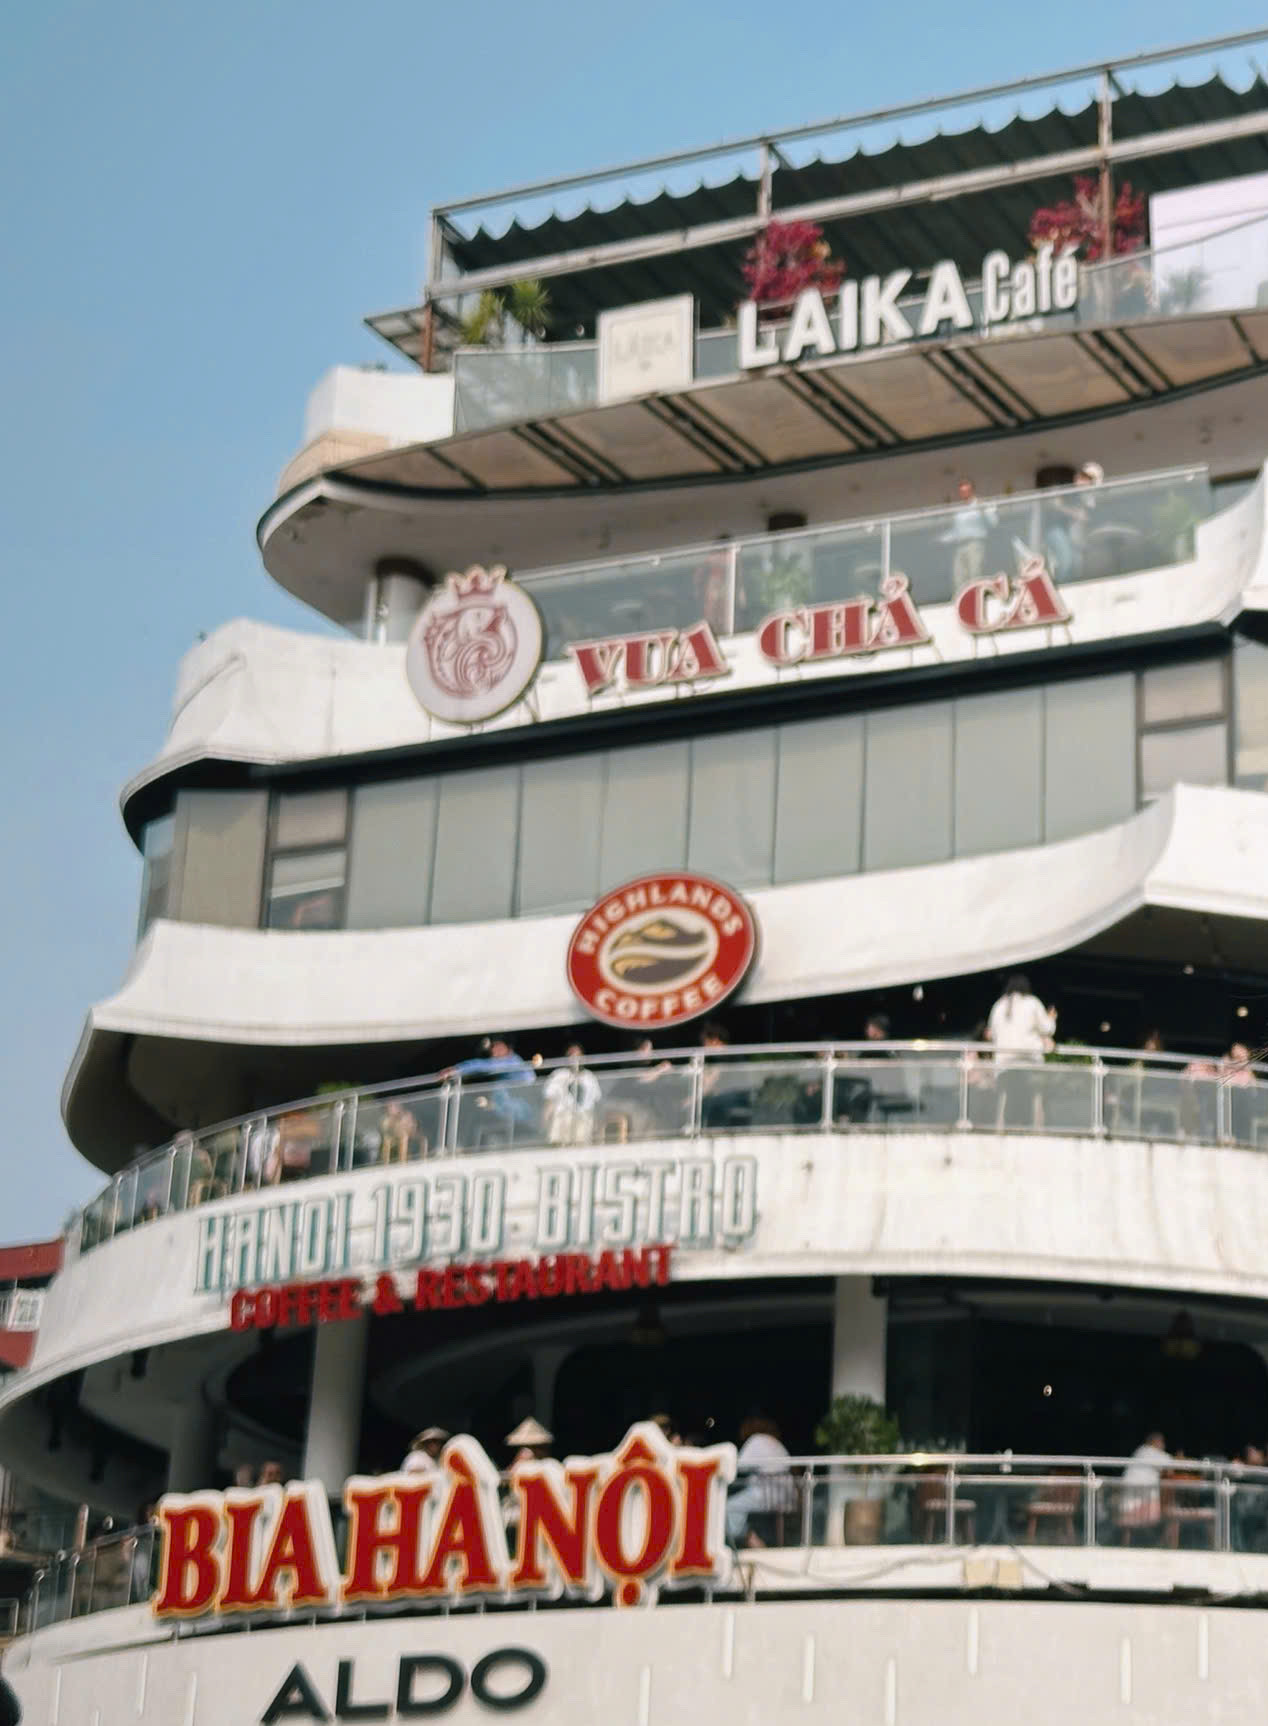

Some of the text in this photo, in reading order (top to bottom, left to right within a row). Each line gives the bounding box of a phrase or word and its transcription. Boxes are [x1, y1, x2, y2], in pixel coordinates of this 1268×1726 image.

[738, 259, 975, 370] LAIKA
[981, 240, 1079, 322] Café
[567, 621, 730, 692] VUA
[577, 882, 745, 955] HIGHLANDS
[594, 972, 723, 1019] COFFEE
[194, 1153, 758, 1294] HANOI 1930 BISTRO
[230, 1243, 677, 1332] COFFEE & RESTAURANT
[153, 1485, 338, 1620] BIA
[508, 1422, 737, 1610] NỘI
[258, 1645, 548, 1726] ALDO
